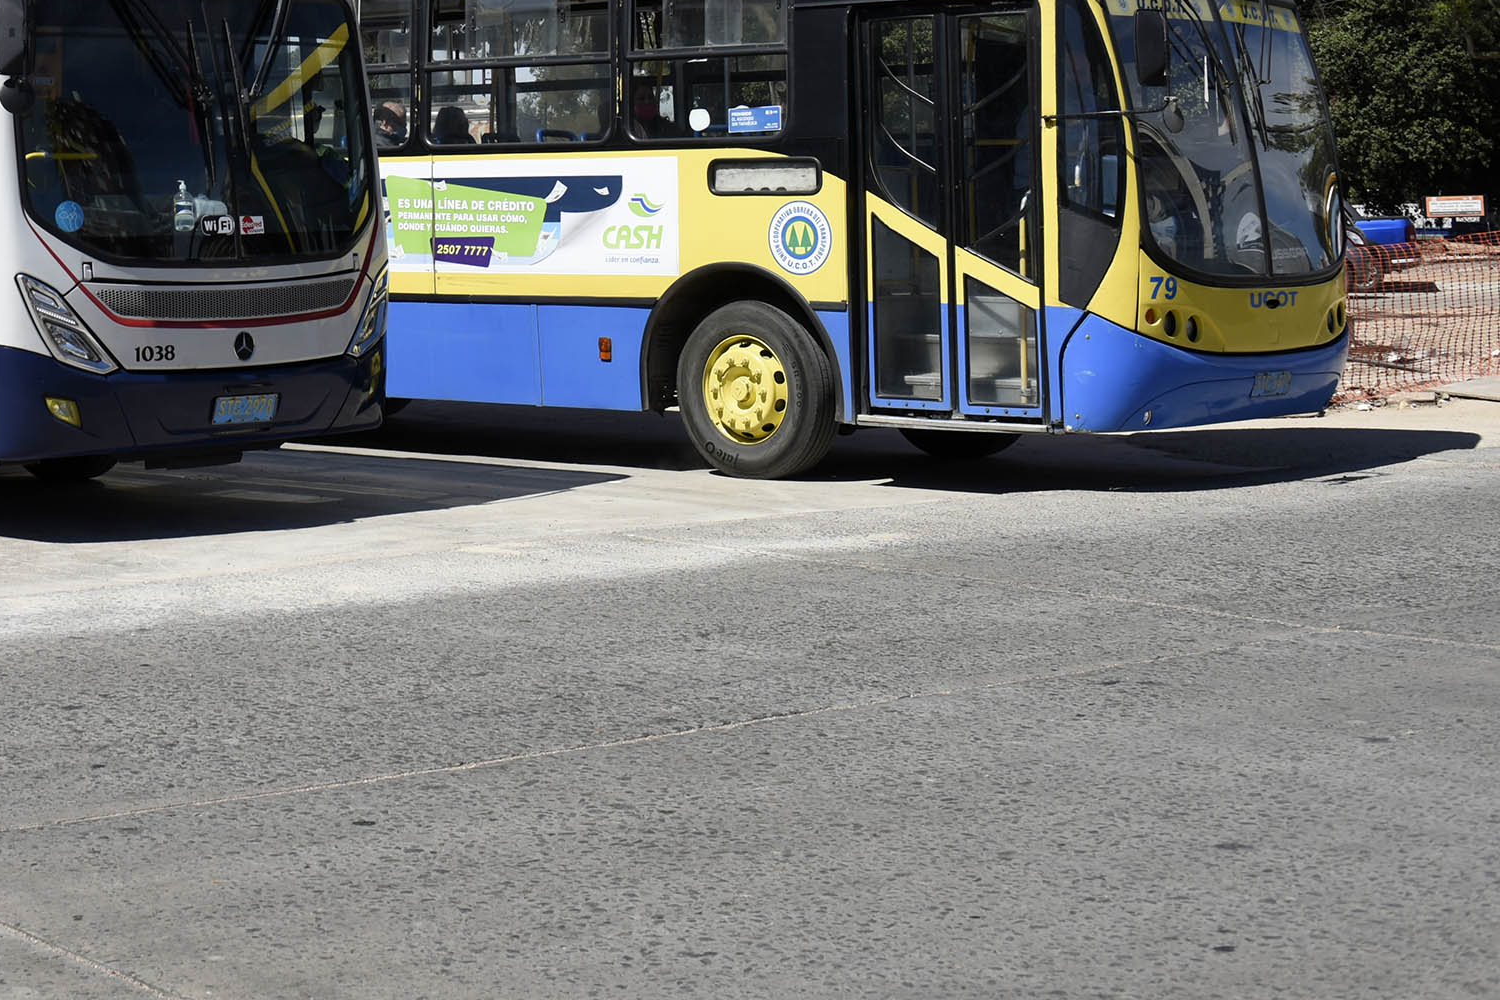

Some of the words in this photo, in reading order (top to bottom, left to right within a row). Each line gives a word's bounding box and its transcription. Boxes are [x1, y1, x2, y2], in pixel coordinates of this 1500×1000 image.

[398, 199, 410, 209] ES
[413, 199, 433, 209] UNA
[438, 197, 468, 210] LÍNEA
[471, 200, 485, 210] DE
[487, 198, 535, 212] CRÉDITO
[453, 213, 474, 221] PARA
[476, 213, 499, 222] USAR
[602, 225, 663, 249] CASH
[437, 244, 462, 255] 2507
[464, 245, 488, 256] 7777
[1150, 276, 1178, 300] 79
[1250, 291, 1298, 308] UCOT
[135, 345, 176, 362] 1038
